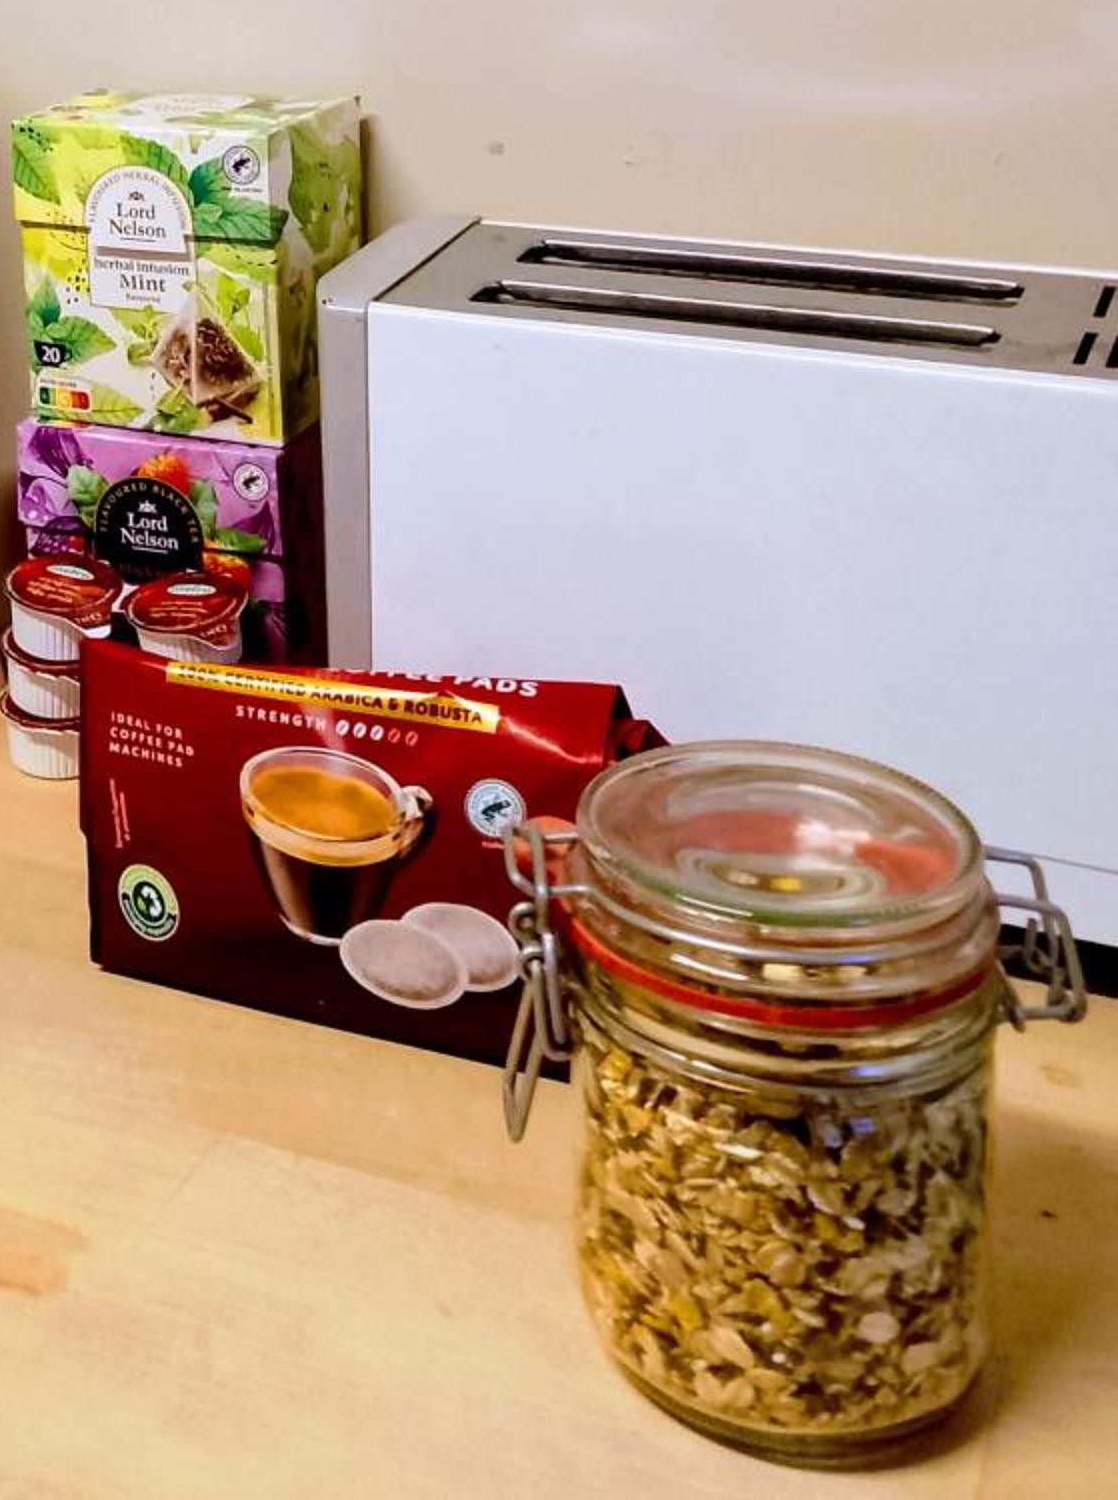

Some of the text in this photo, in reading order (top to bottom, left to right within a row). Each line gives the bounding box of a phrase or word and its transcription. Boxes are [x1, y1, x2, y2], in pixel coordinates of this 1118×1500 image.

[116, 201, 156, 220] Lord
[108, 219, 167, 239] Nelson
[119, 273, 166, 292] Mint
[41, 345, 61, 363] 20
[126, 511, 168, 532] Lord
[120, 527, 179, 550] Nelson
[235, 705, 327, 732] STRENGTH
[403, 699, 483, 724] ROBUSTA
[111, 711, 182, 739] IDEAL FOR
[109, 726, 194, 757] COFFEE PAD
[109, 741, 182, 768] MACHINES
